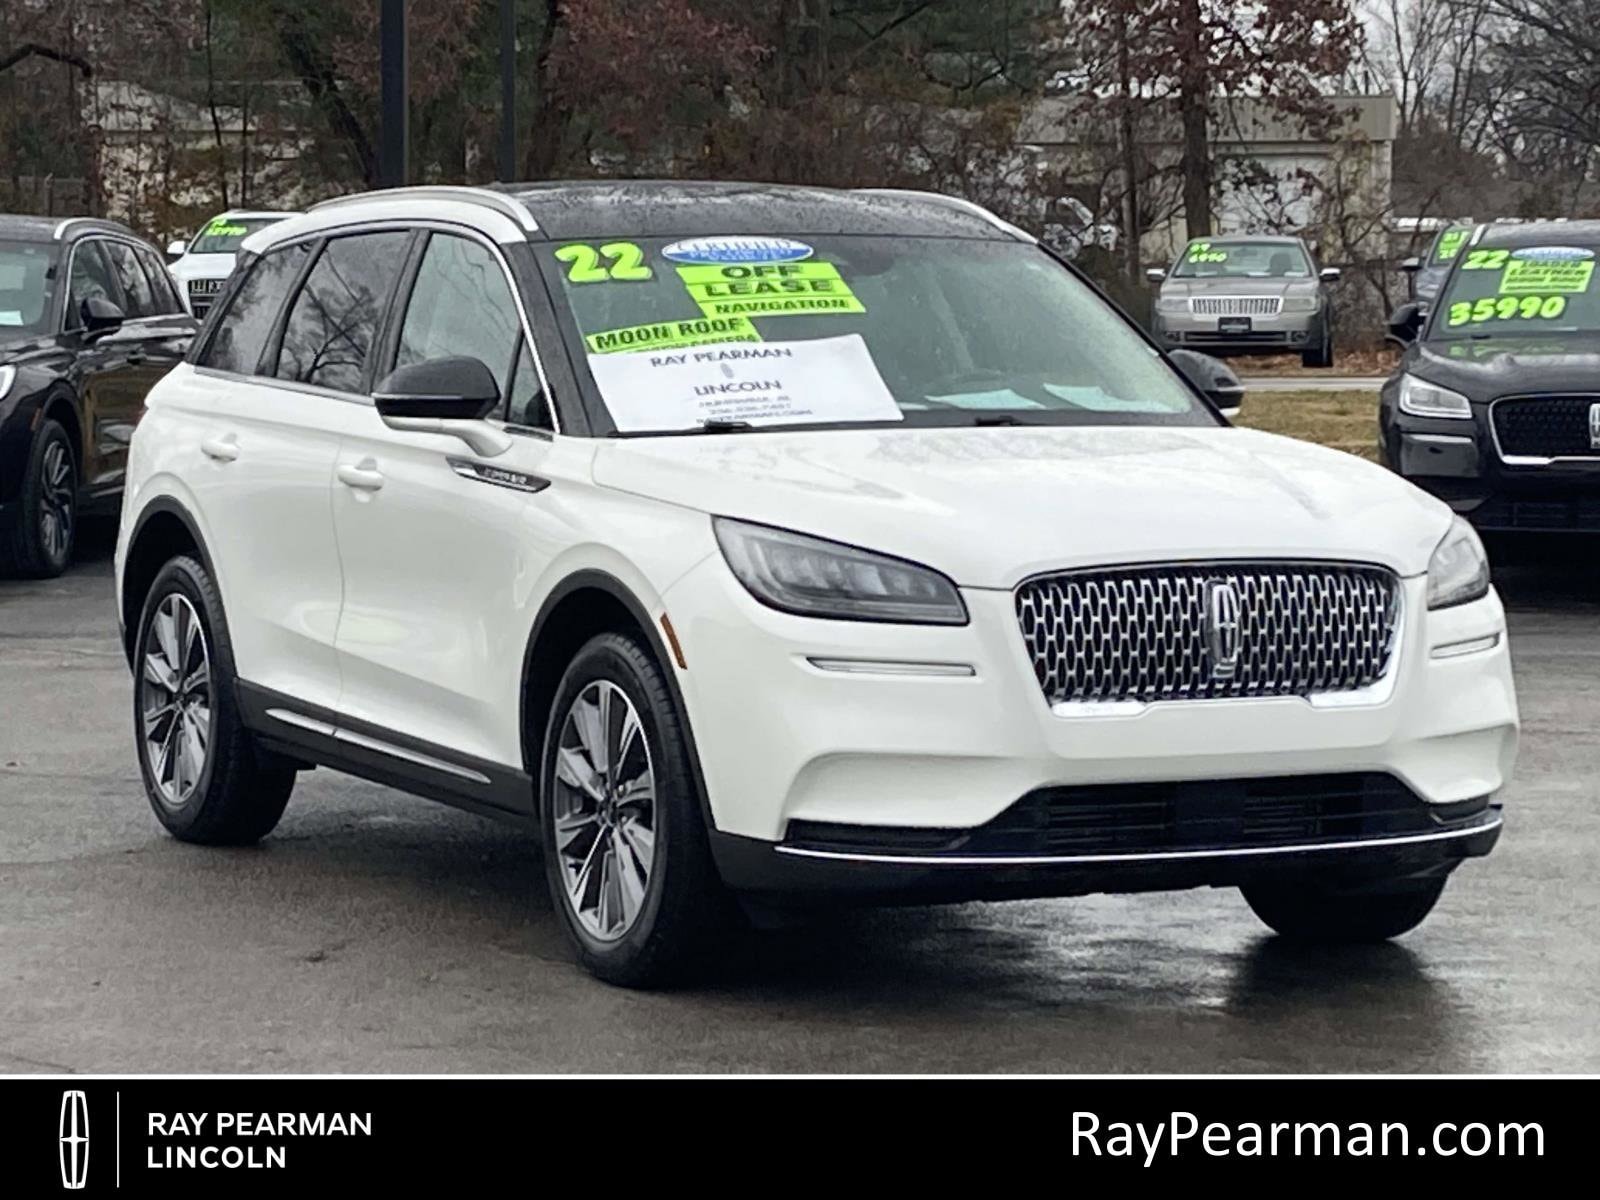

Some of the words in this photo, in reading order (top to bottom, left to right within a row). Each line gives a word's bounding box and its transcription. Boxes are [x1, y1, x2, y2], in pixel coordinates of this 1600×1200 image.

[555, 242, 652, 283] 22
[1462, 250, 1510, 269] 22
[721, 265, 803, 279] OFF
[704, 280, 834, 297] LEASE
[715, 299, 849, 314] NAVIGATION
[1448, 296, 1566, 326] 35990
[595, 325, 669, 349] MOON
[678, 318, 743, 338] ROOF
[650, 354, 687, 368] RAY
[693, 347, 793, 362] PEARMAN
[694, 380, 782, 396] LINCOLN
